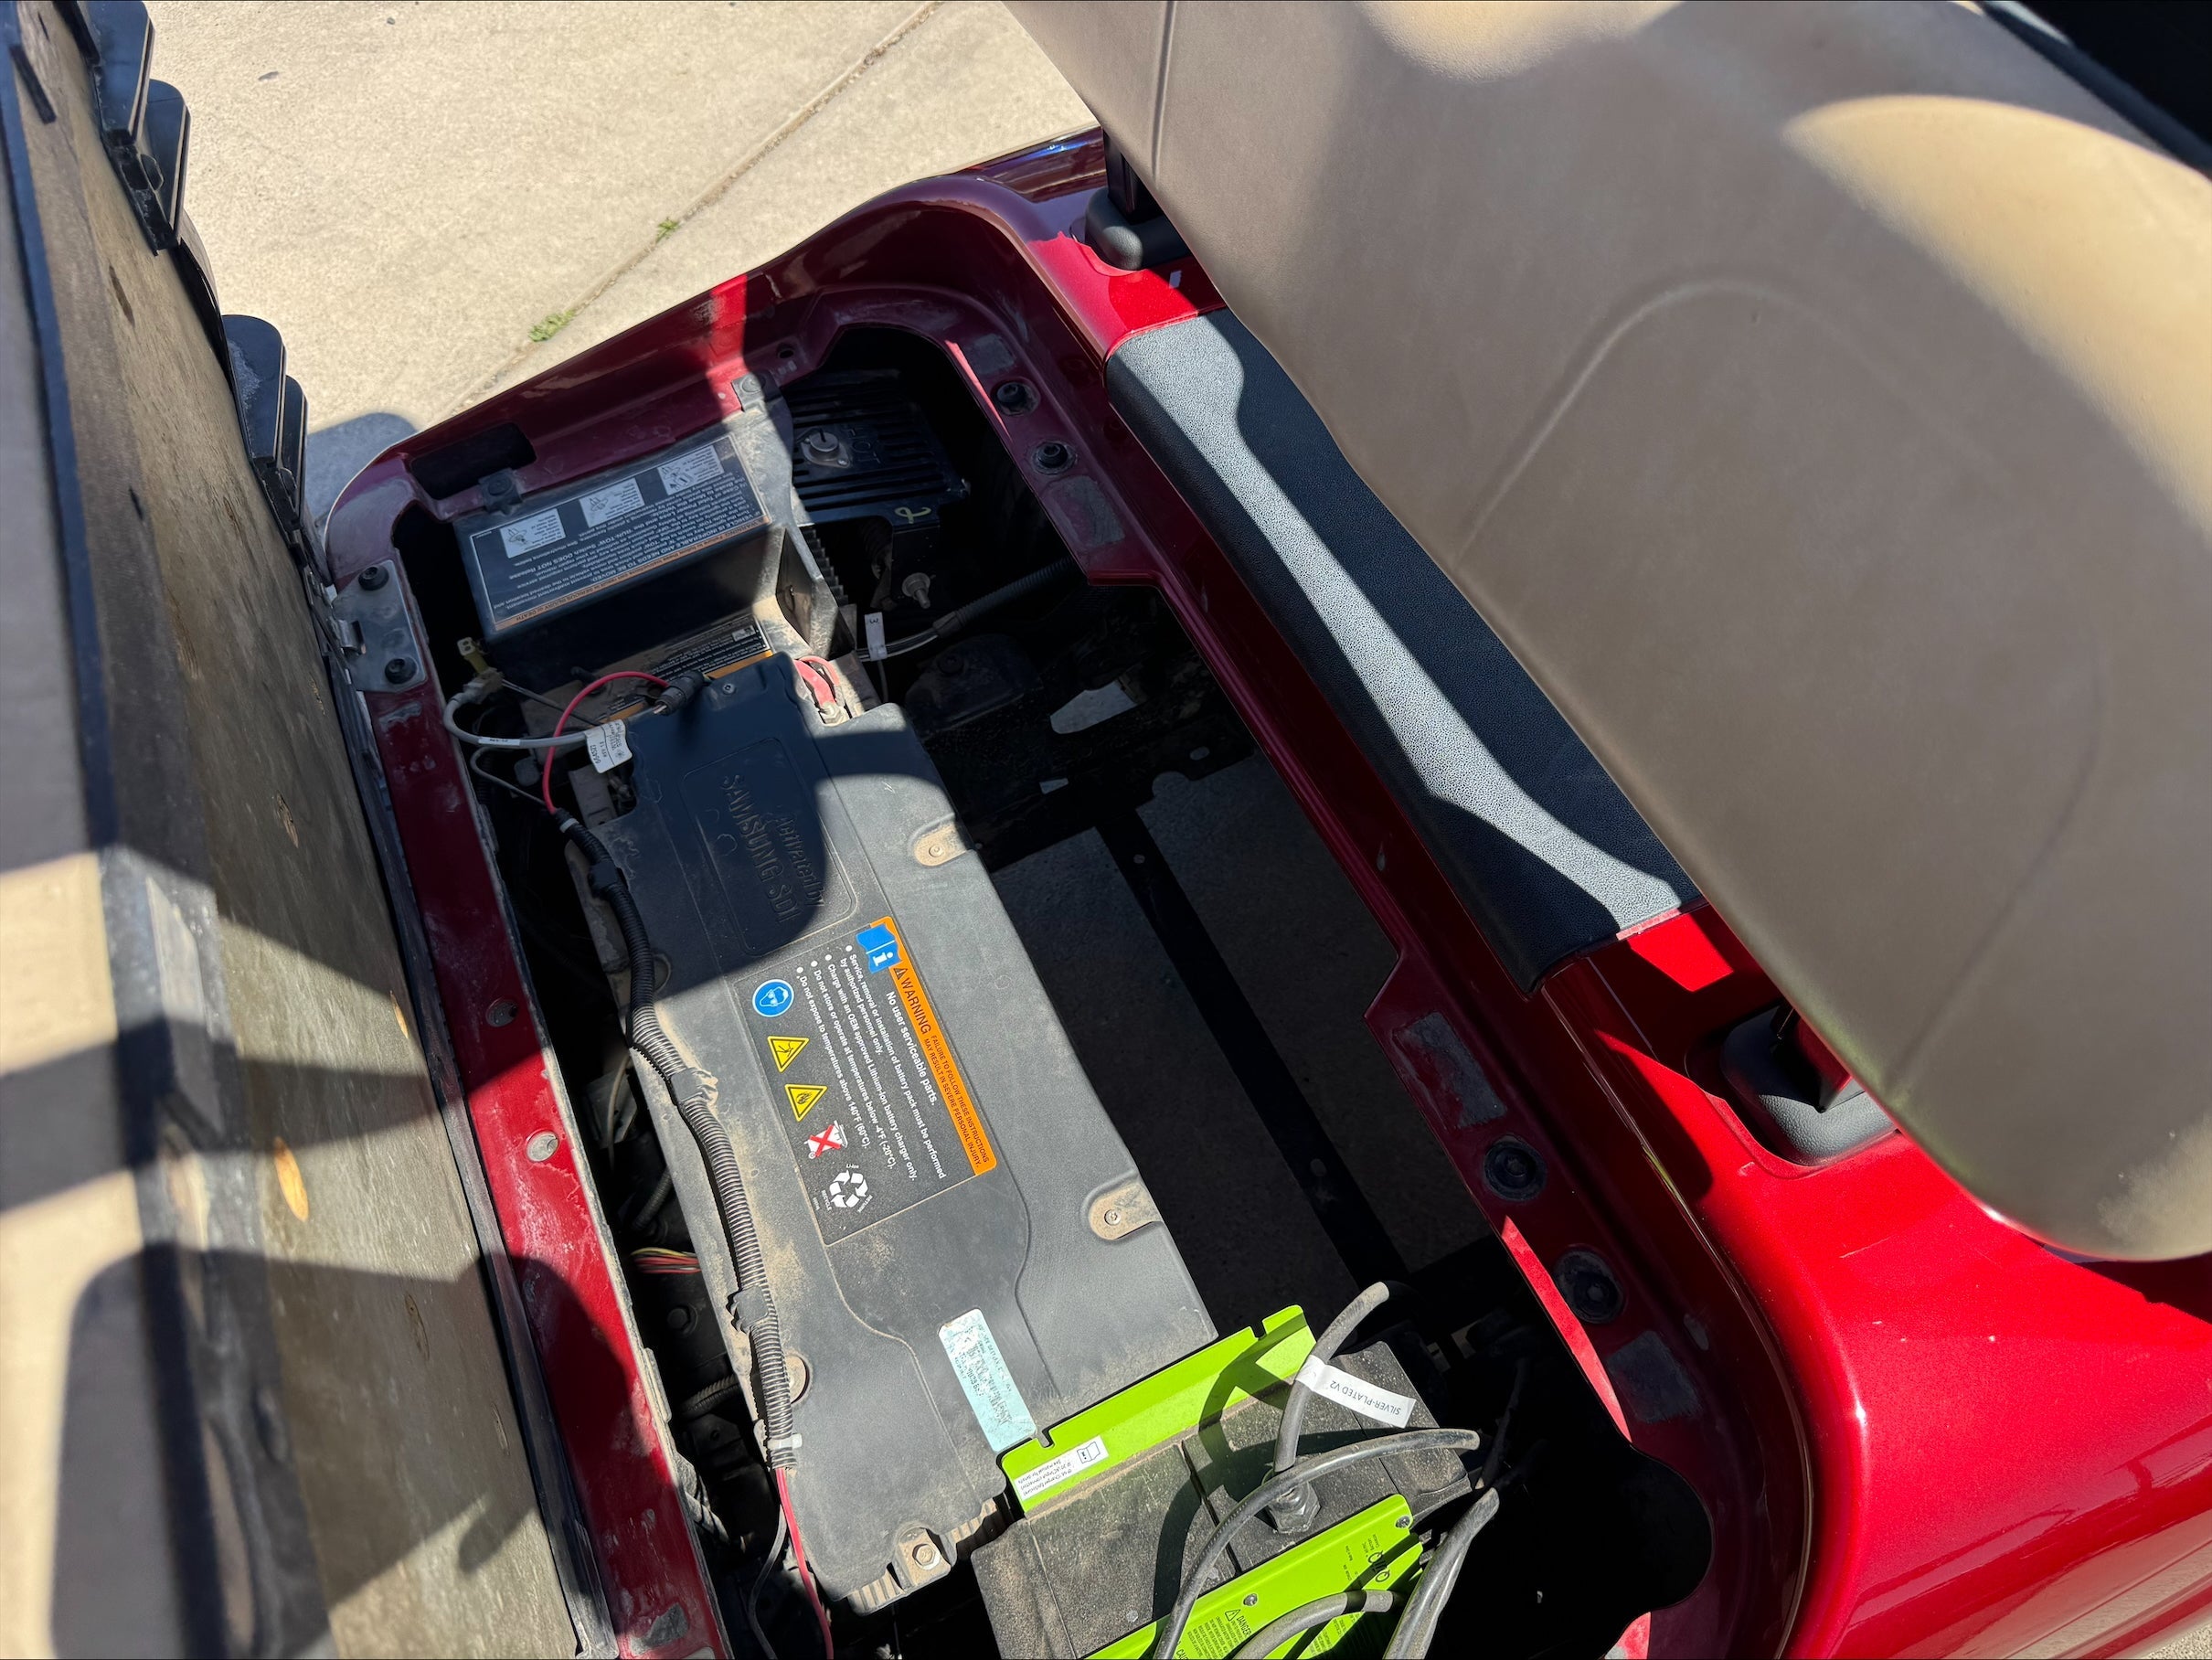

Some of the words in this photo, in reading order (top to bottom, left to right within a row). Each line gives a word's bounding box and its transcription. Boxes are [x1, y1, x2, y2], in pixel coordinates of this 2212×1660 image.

[725, 512, 753, 528] VEHICLE
[636, 549, 660, 563] NEEDS
[660, 544, 675, 554] AND
[616, 563, 626, 571] BE
[626, 559, 636, 568] TO
[720, 774, 784, 884] SAMSUNG
[766, 883, 803, 923] SDI
[813, 968, 824, 981] Do
[824, 962, 843, 989] Charge
[847, 952, 866, 982] Service,
[798, 974, 809, 987] Do
[817, 979, 828, 994] not
[803, 985, 814, 1000] not
[822, 991, 835, 1011] store
[836, 986, 849, 1005] with
[859, 980, 877, 1009] removal
[885, 990, 899, 1006] No
[806, 998, 823, 1026] expose
[829, 1010, 837, 1020] or
[837, 956, 849, 968] by
[843, 966, 864, 1004] authorized
[856, 1002, 877, 1038] personnel
[869, 1036, 885, 1056] only.
[843, 1003, 852, 1014] an
[870, 1007, 879, 1017] or
[891, 1005, 906, 1027] user
[899, 976, 932, 1035] WARNING
[817, 1023, 826, 1034] to
[831, 1018, 849, 1048] operate
[846, 1012, 860, 1031] OEM
[852, 1029, 873, 1065] approved
[874, 1016, 897, 1056] installation
[922, 1038, 933, 1052] MAY
[930, 1035, 945, 1060] FAILURE
[819, 1031, 845, 1080] temperatures
[889, 1055, 900, 1065] of
[899, 1025, 929, 1078] serviceable
[928, 1051, 943, 1076] RESULT
[941, 1060, 950, 1069] TO
[845, 1053, 870, 1102] temperatures
[867, 1062, 889, 1105] Lithium-Ion
[892, 1062, 910, 1091] battery
[938, 1075, 946, 1083] IN
[944, 1069, 961, 1096] FOLLOW
[838, 1078, 854, 1101] above
[902, 1089, 918, 1110] pack
[919, 1077, 939, 1107] parts.
[941, 1082, 957, 1108] SEVERE
[846, 1101, 862, 1123] 140°F
[864, 1100, 879, 1124] below
[956, 1095, 970, 1116] THESE
[881, 1103, 900, 1133] battery
[910, 1107, 926, 1129] must
[952, 1107, 972, 1142] PERSONAL
[873, 1123, 887, 1141] -4°F
[919, 1126, 931, 1139] be
[964, 1115, 990, 1163] INSTRUCTIONS
[891, 1130, 912, 1163] charger
[966, 1141, 983, 1167] INJURY.
[922, 1137, 947, 1180] performed
[903, 1159, 920, 1182] only.
[820, 1188, 833, 1211] RECYCLE
[1329, 1379, 1340, 1390] V2
[1342, 1386, 1401, 1415] SILVER-PLATED
[1235, 1614, 1252, 1636] DANGER
